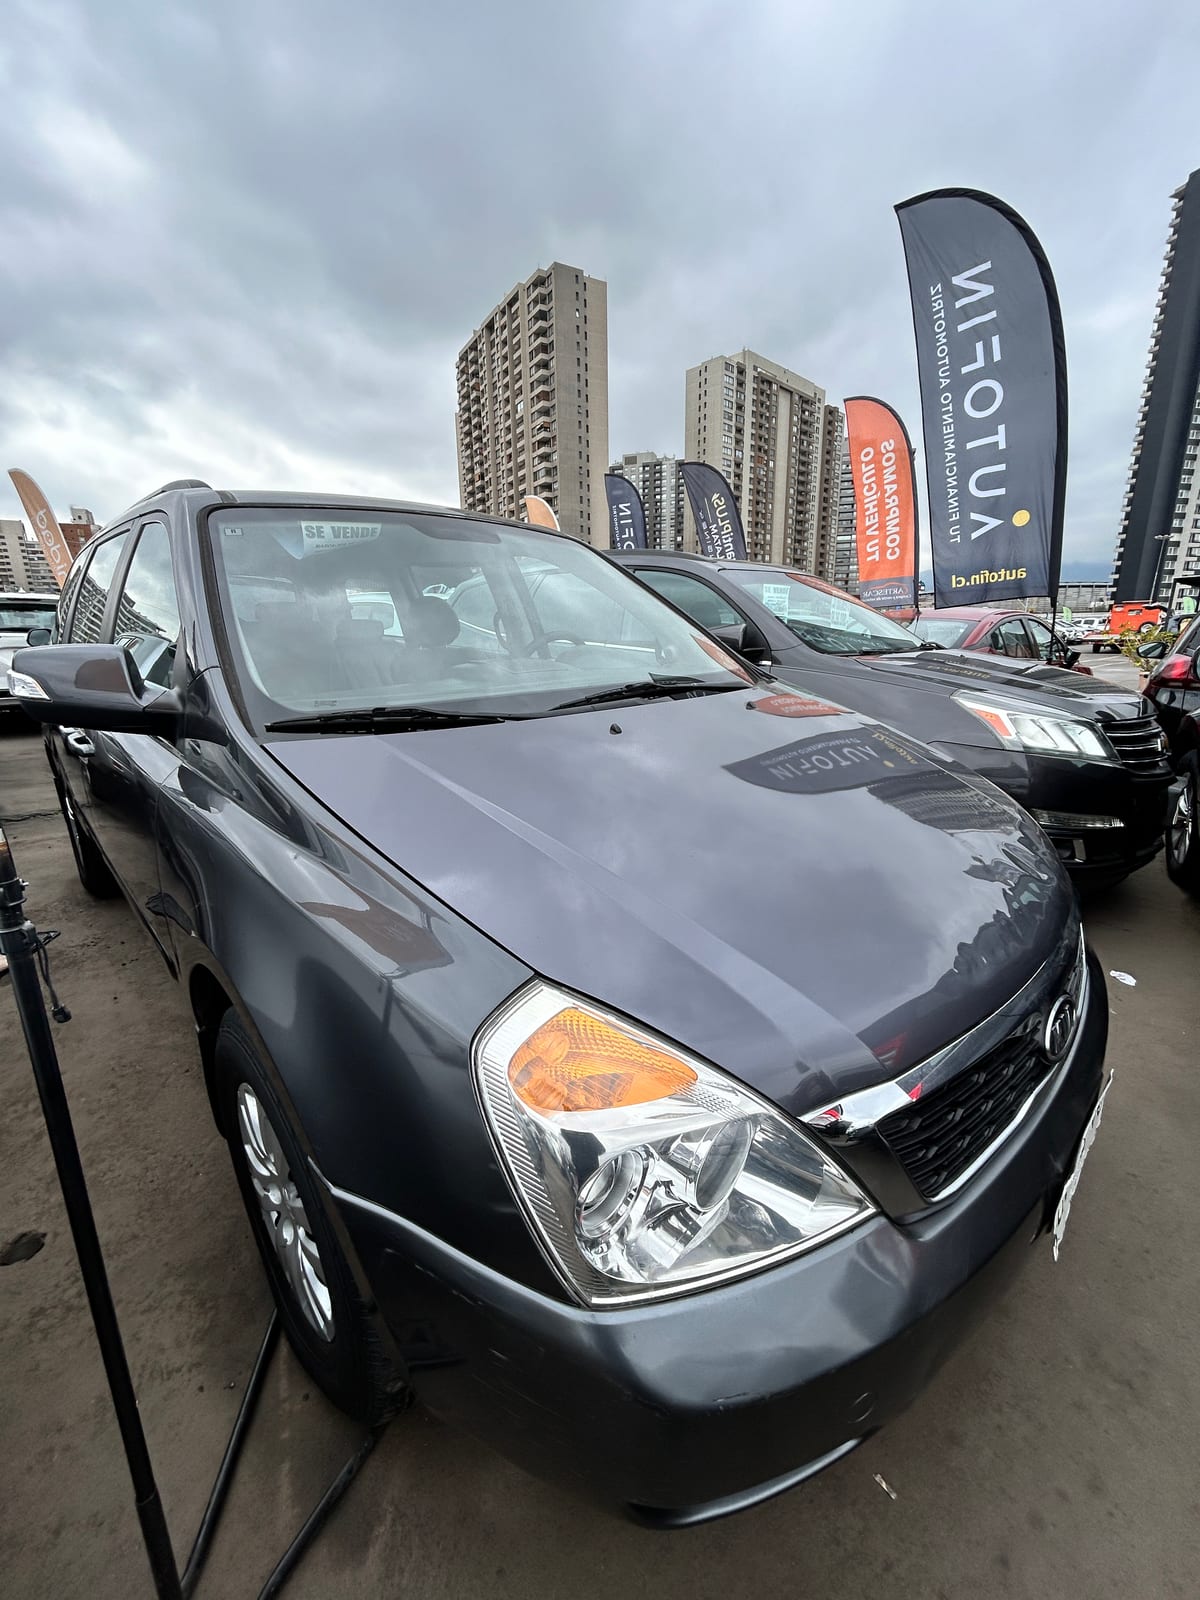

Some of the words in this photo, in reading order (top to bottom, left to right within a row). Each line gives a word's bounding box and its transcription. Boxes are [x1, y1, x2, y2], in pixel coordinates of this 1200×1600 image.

[304, 525, 325, 539] SE
[330, 526, 378, 539] VENDE
[768, 745, 880, 780] AUTOFIN
